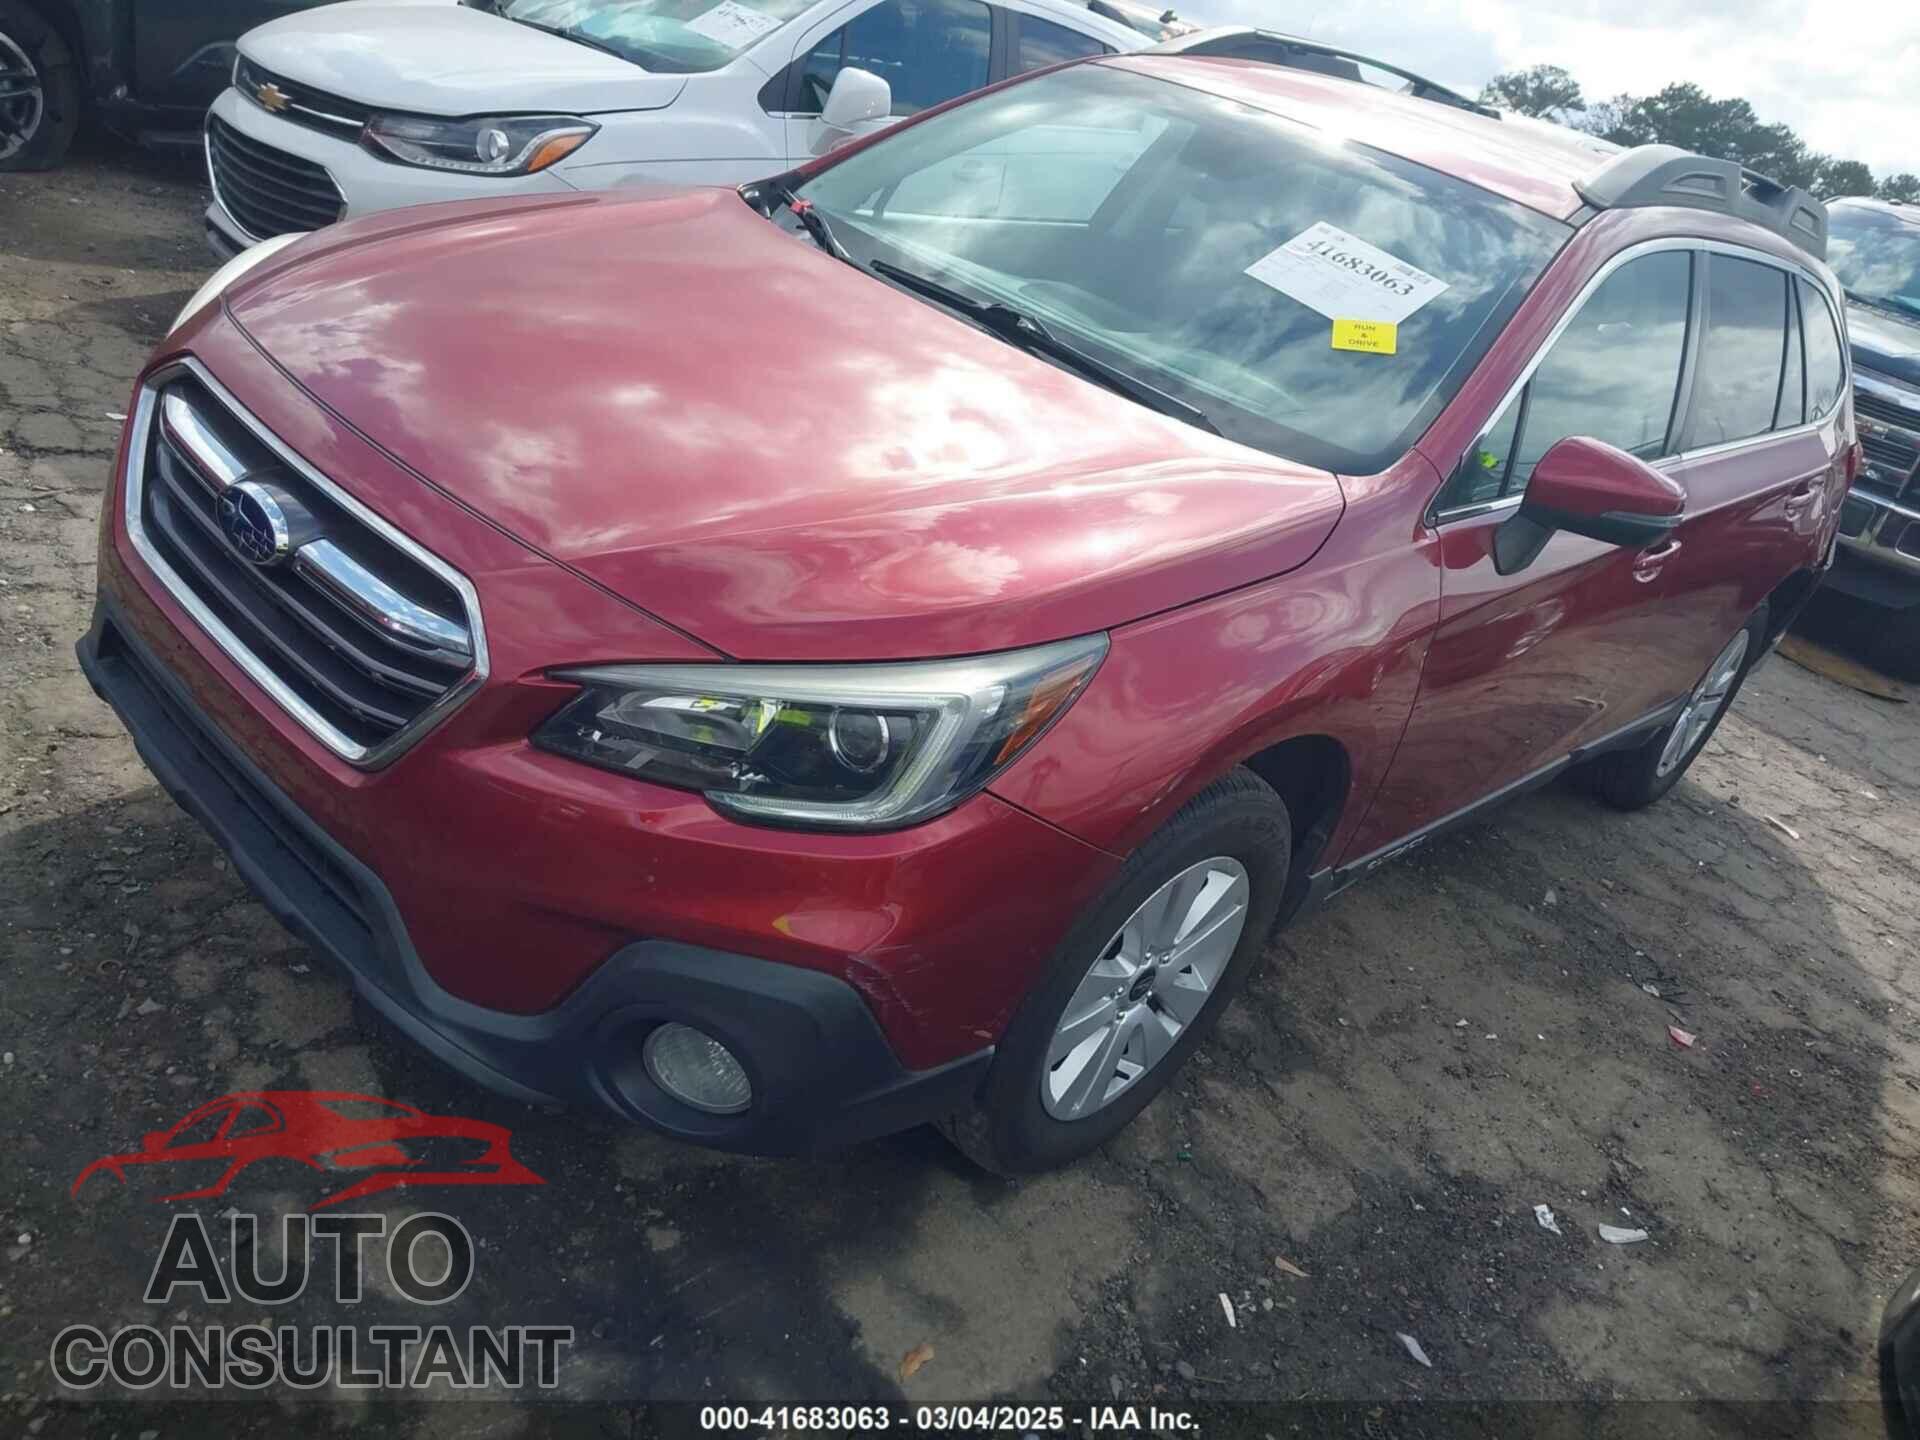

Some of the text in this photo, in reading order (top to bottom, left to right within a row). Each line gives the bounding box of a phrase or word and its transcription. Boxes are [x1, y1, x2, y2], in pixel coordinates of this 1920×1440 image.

[1307, 241, 1414, 295] 41683063
[1353, 324, 1376, 332] RUN
[1348, 338, 1379, 348] DRIVE
